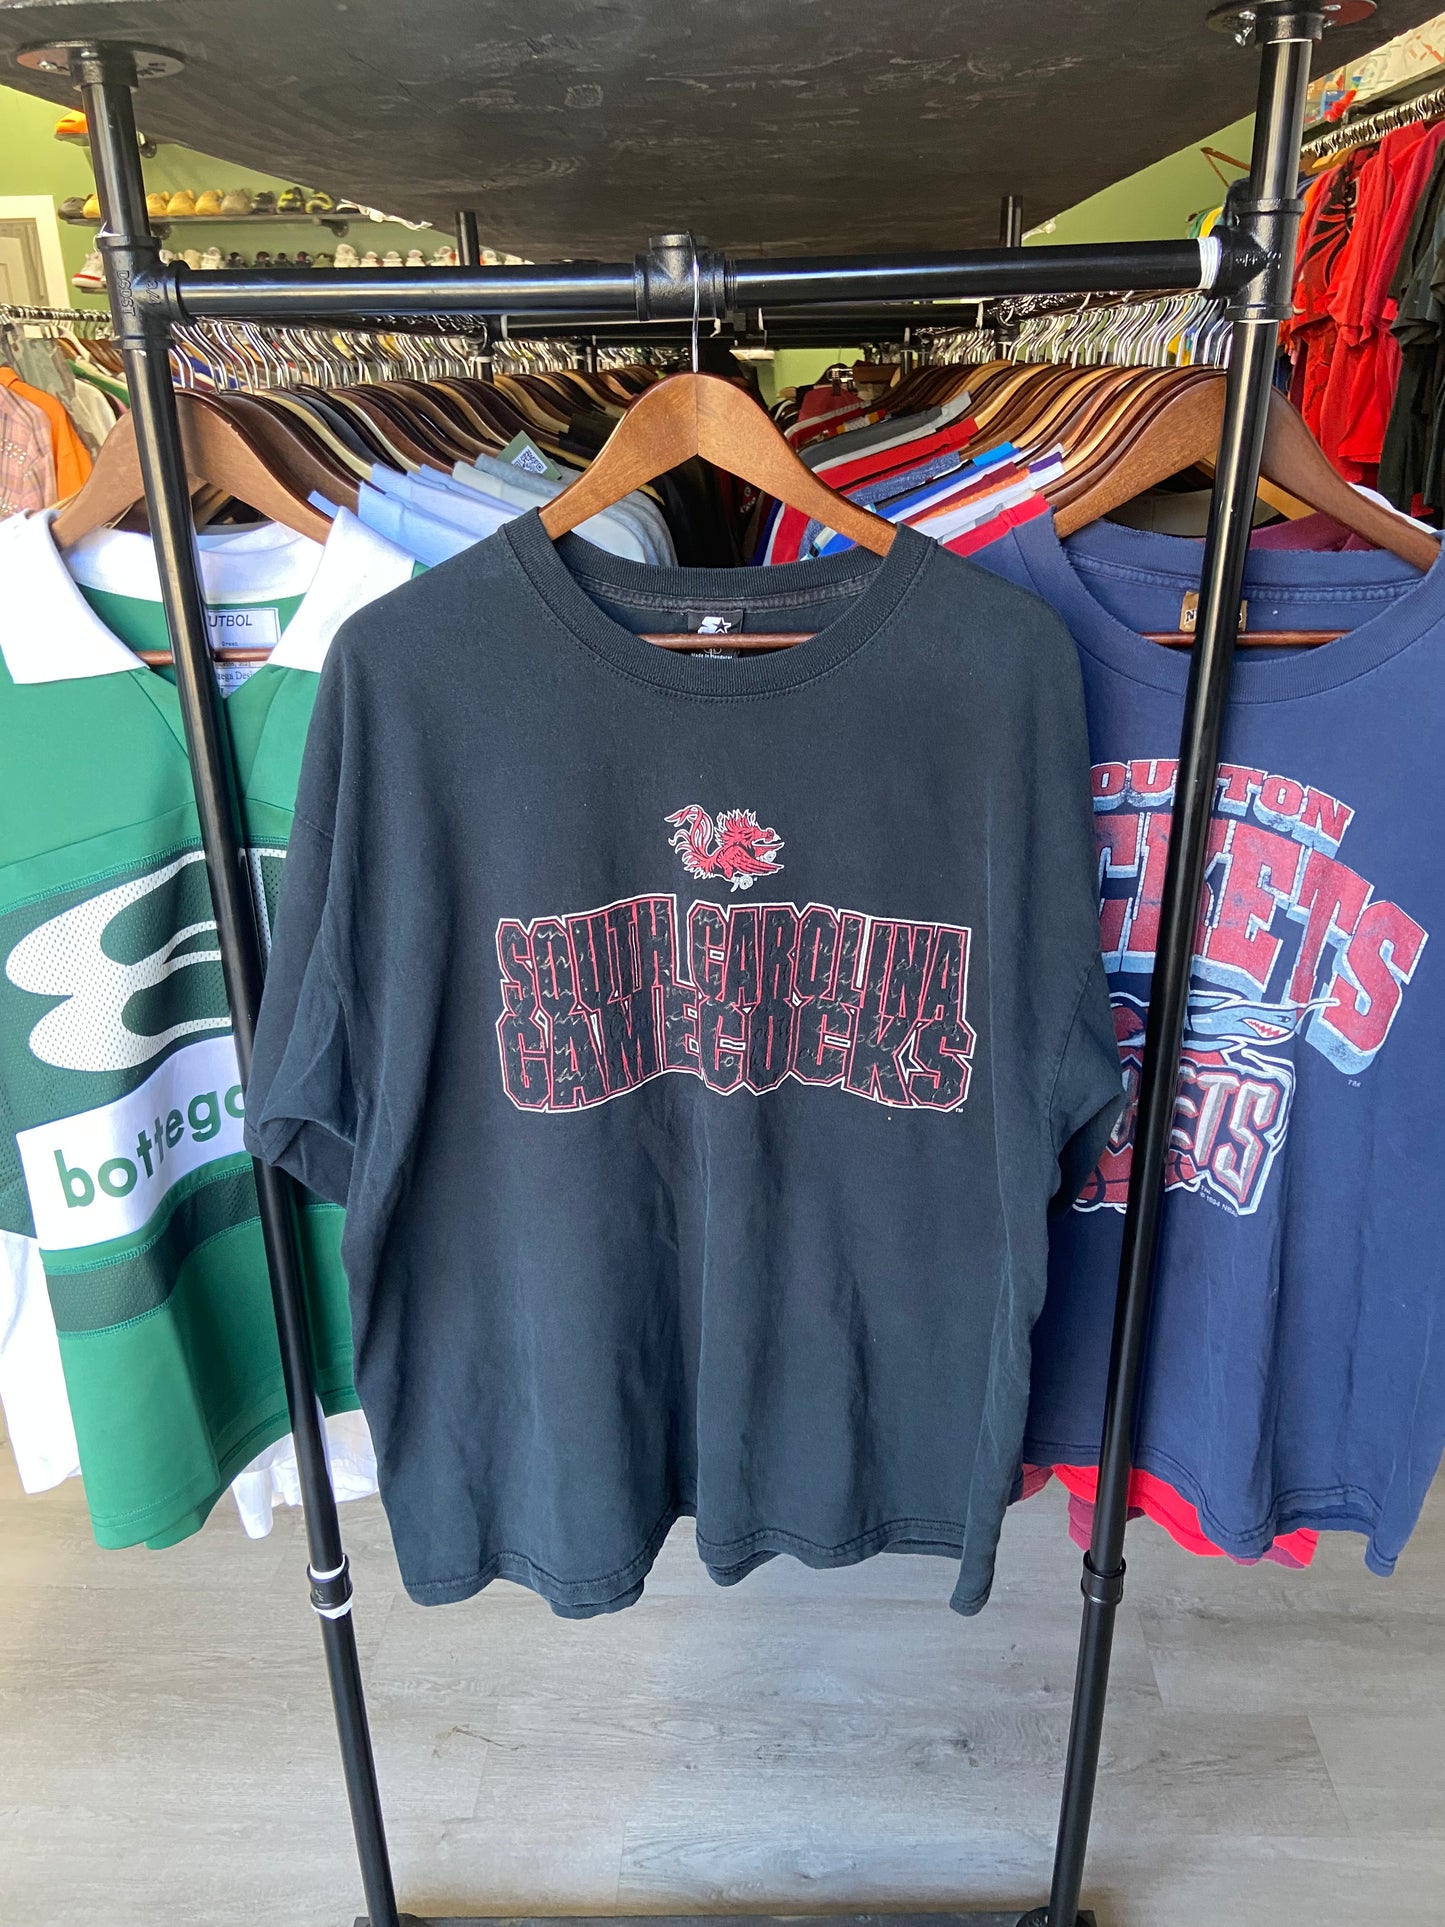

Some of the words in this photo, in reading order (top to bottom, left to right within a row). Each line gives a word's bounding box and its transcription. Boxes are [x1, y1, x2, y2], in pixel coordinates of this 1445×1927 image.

[208, 614, 253, 628] UTBOL
[1090, 759, 1355, 850] OUTON
[496, 894, 680, 1012] SOUTH
[687, 899, 972, 1021] CAROLINA
[1095, 811, 1429, 1070] CKETS
[496, 986, 976, 1112] GAMECOCKS
